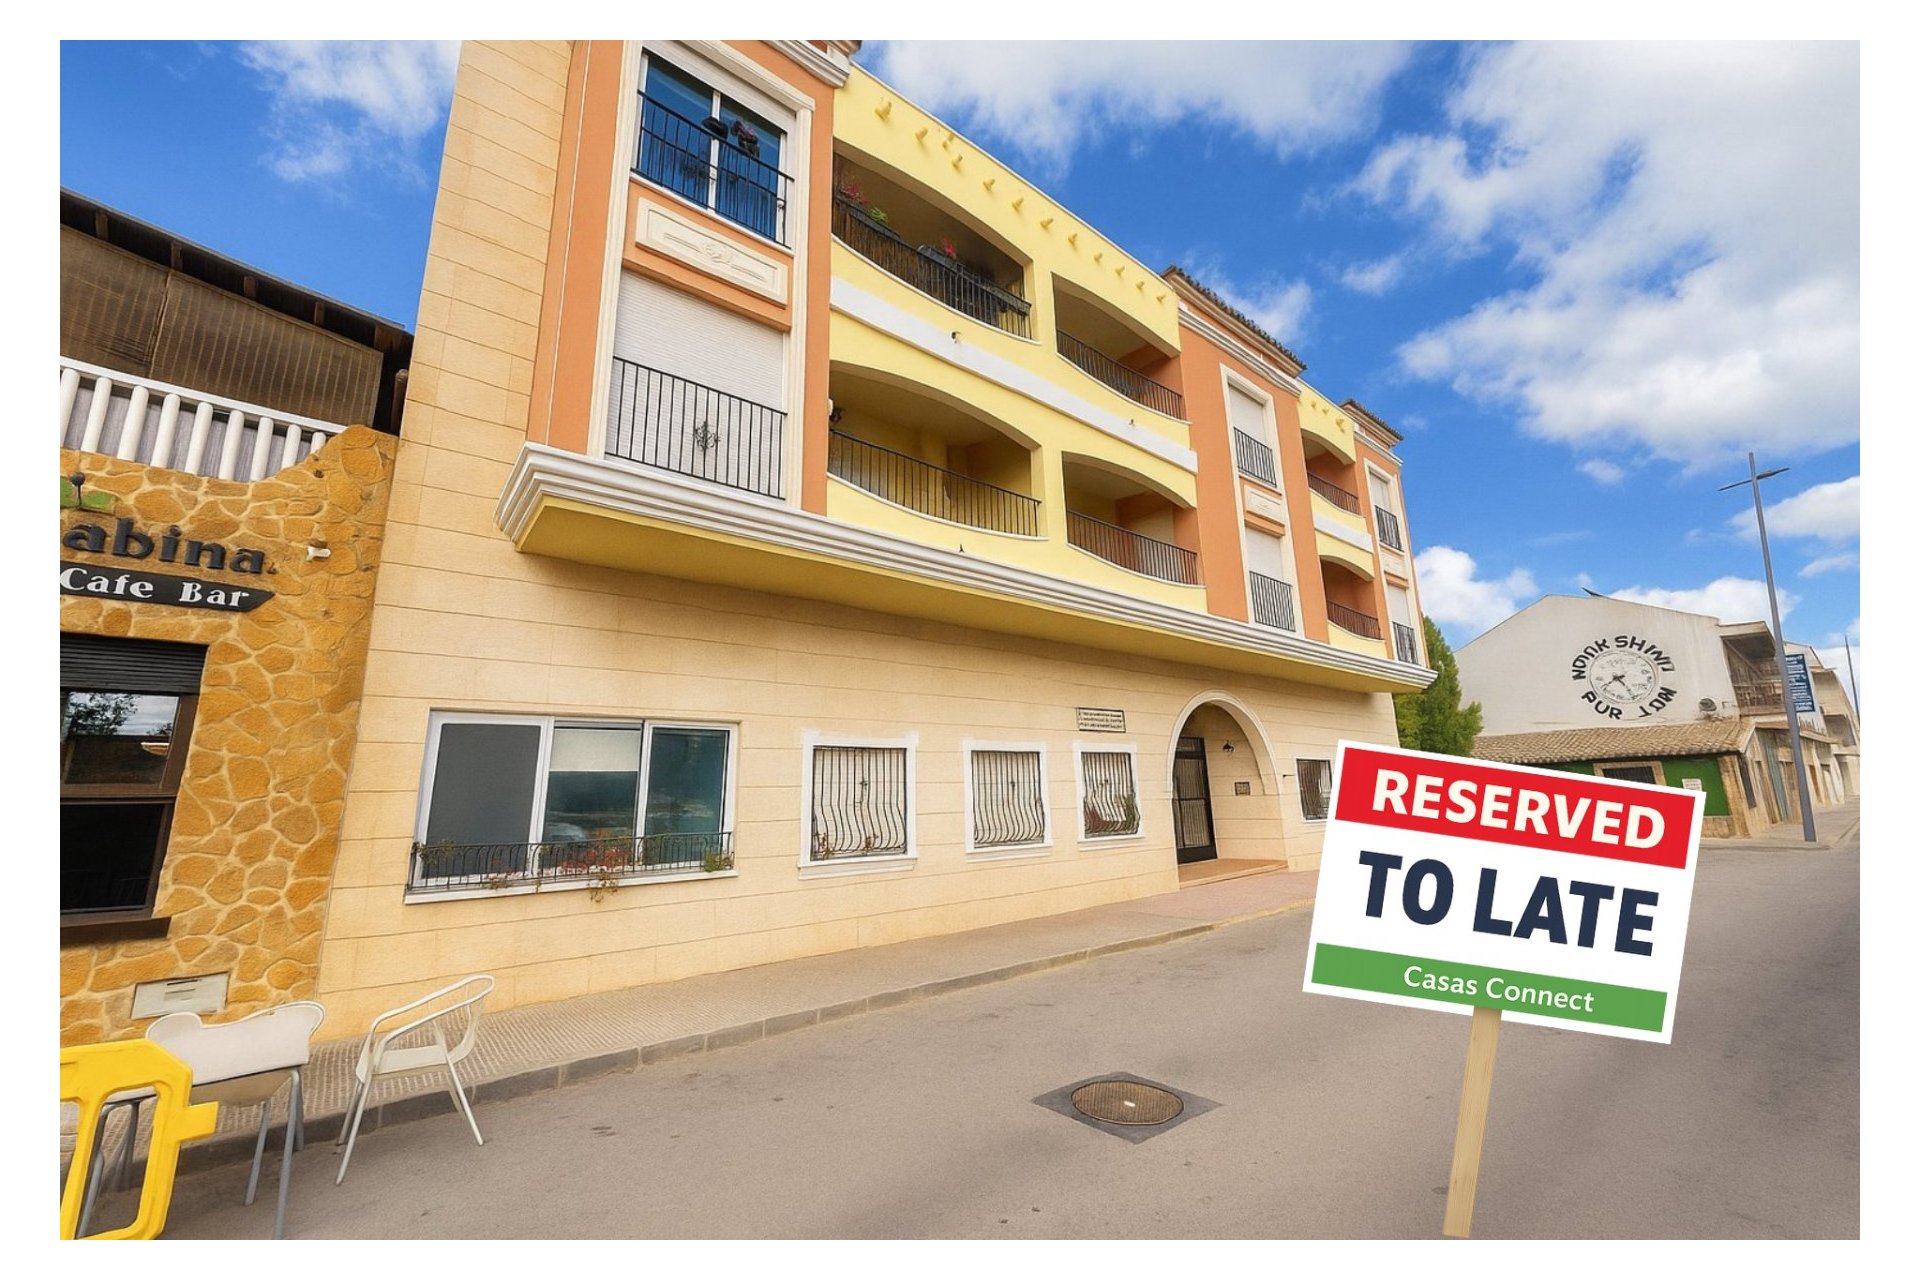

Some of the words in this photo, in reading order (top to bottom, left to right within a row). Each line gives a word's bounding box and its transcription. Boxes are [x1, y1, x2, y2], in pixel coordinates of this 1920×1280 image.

[60, 567, 154, 598] Cafe
[179, 582, 250, 607] Bar
[1372, 768, 1665, 849] RESERVED
[1359, 850, 1454, 926] TO
[1473, 867, 1660, 957] LATE
[1404, 965, 1477, 995] Casas
[1486, 977, 1594, 1012] Connect
